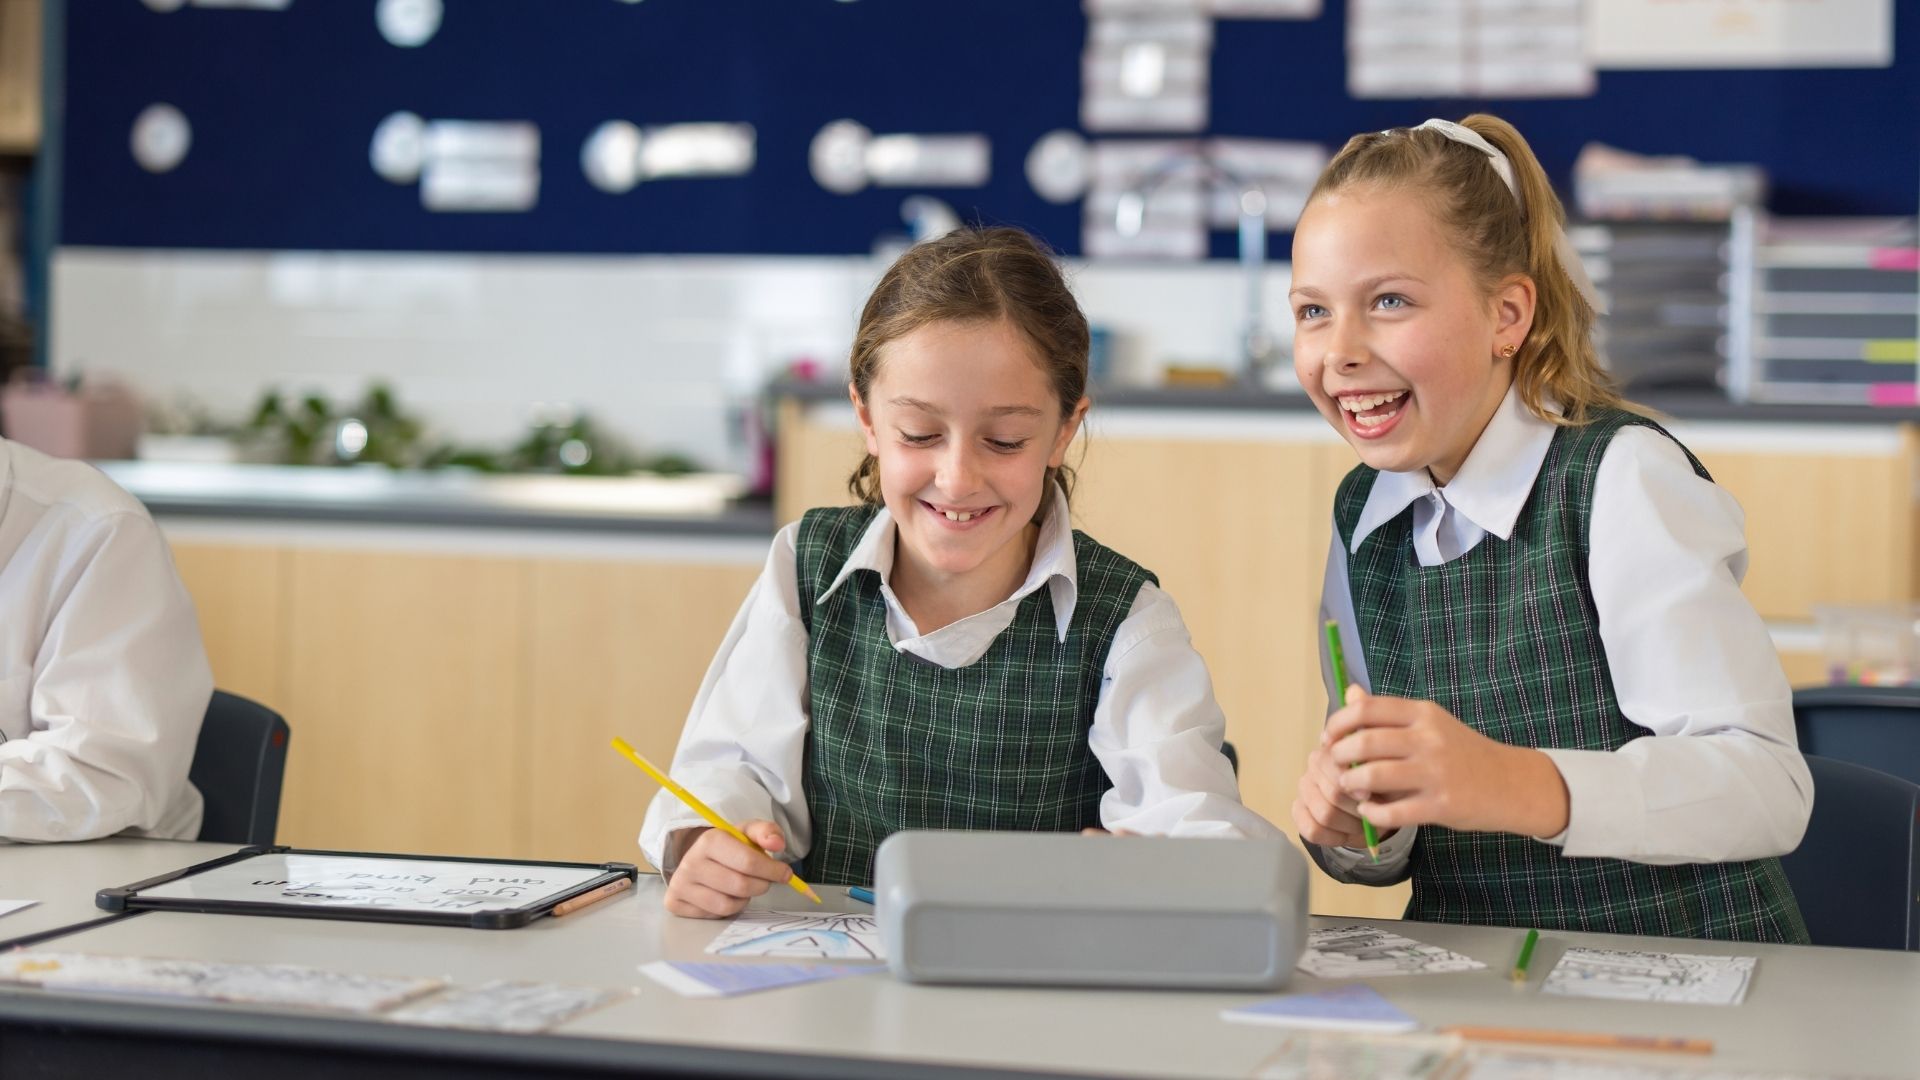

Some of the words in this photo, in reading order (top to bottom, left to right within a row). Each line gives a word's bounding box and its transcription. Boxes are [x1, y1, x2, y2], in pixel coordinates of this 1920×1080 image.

[469, 877, 546, 885] and
[351, 885, 417, 893] are
[441, 886, 528, 898] you
